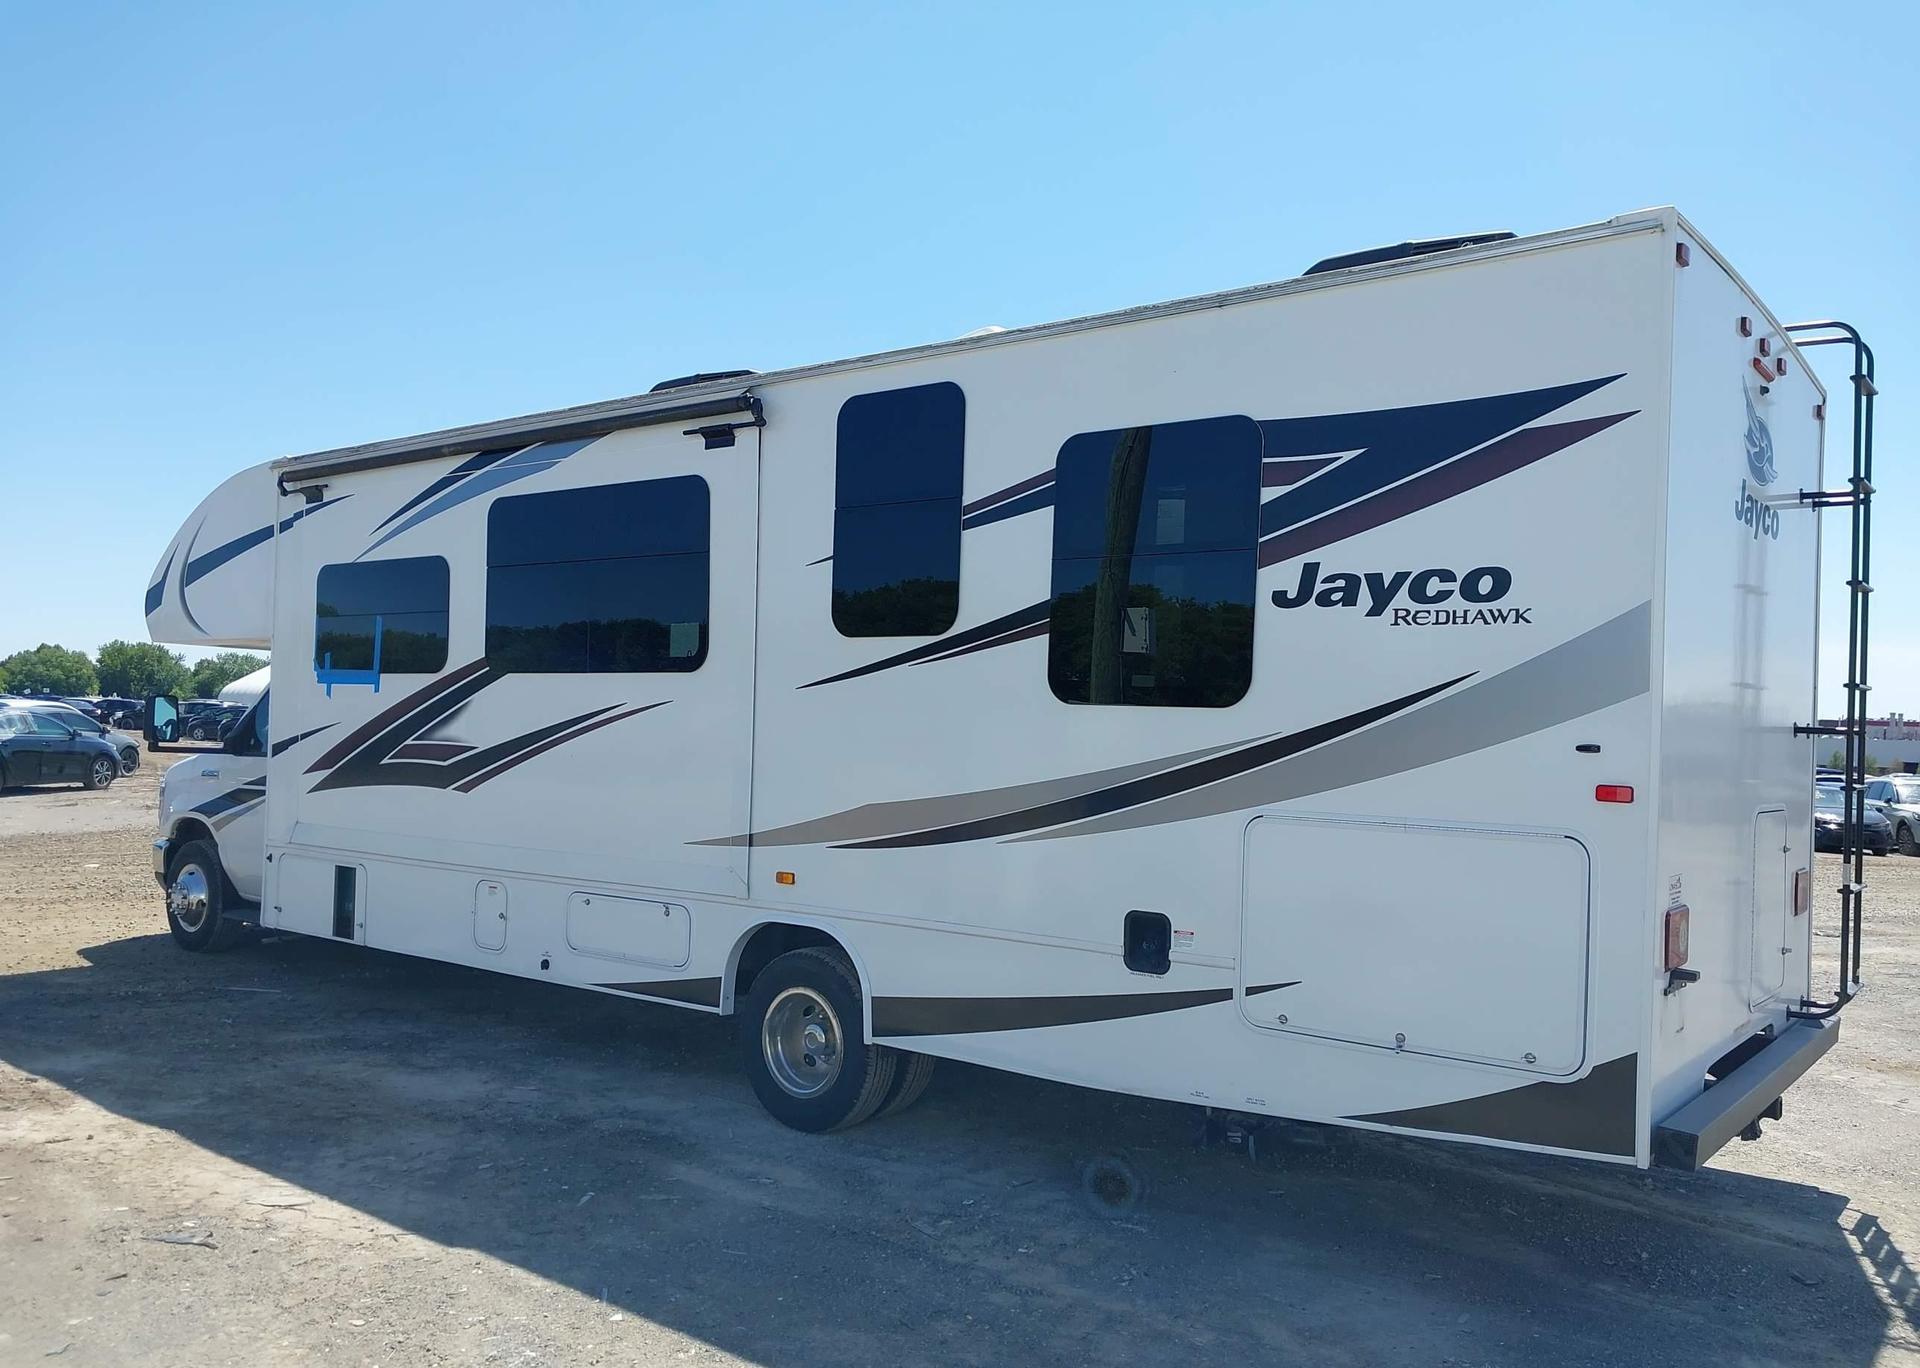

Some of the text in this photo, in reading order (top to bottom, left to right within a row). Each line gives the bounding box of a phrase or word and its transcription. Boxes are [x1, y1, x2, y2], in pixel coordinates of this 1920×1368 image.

[1735, 478, 1779, 541] Jayco
[1271, 561, 1513, 618] Jayco
[1389, 607, 1533, 627] REDHAWK
